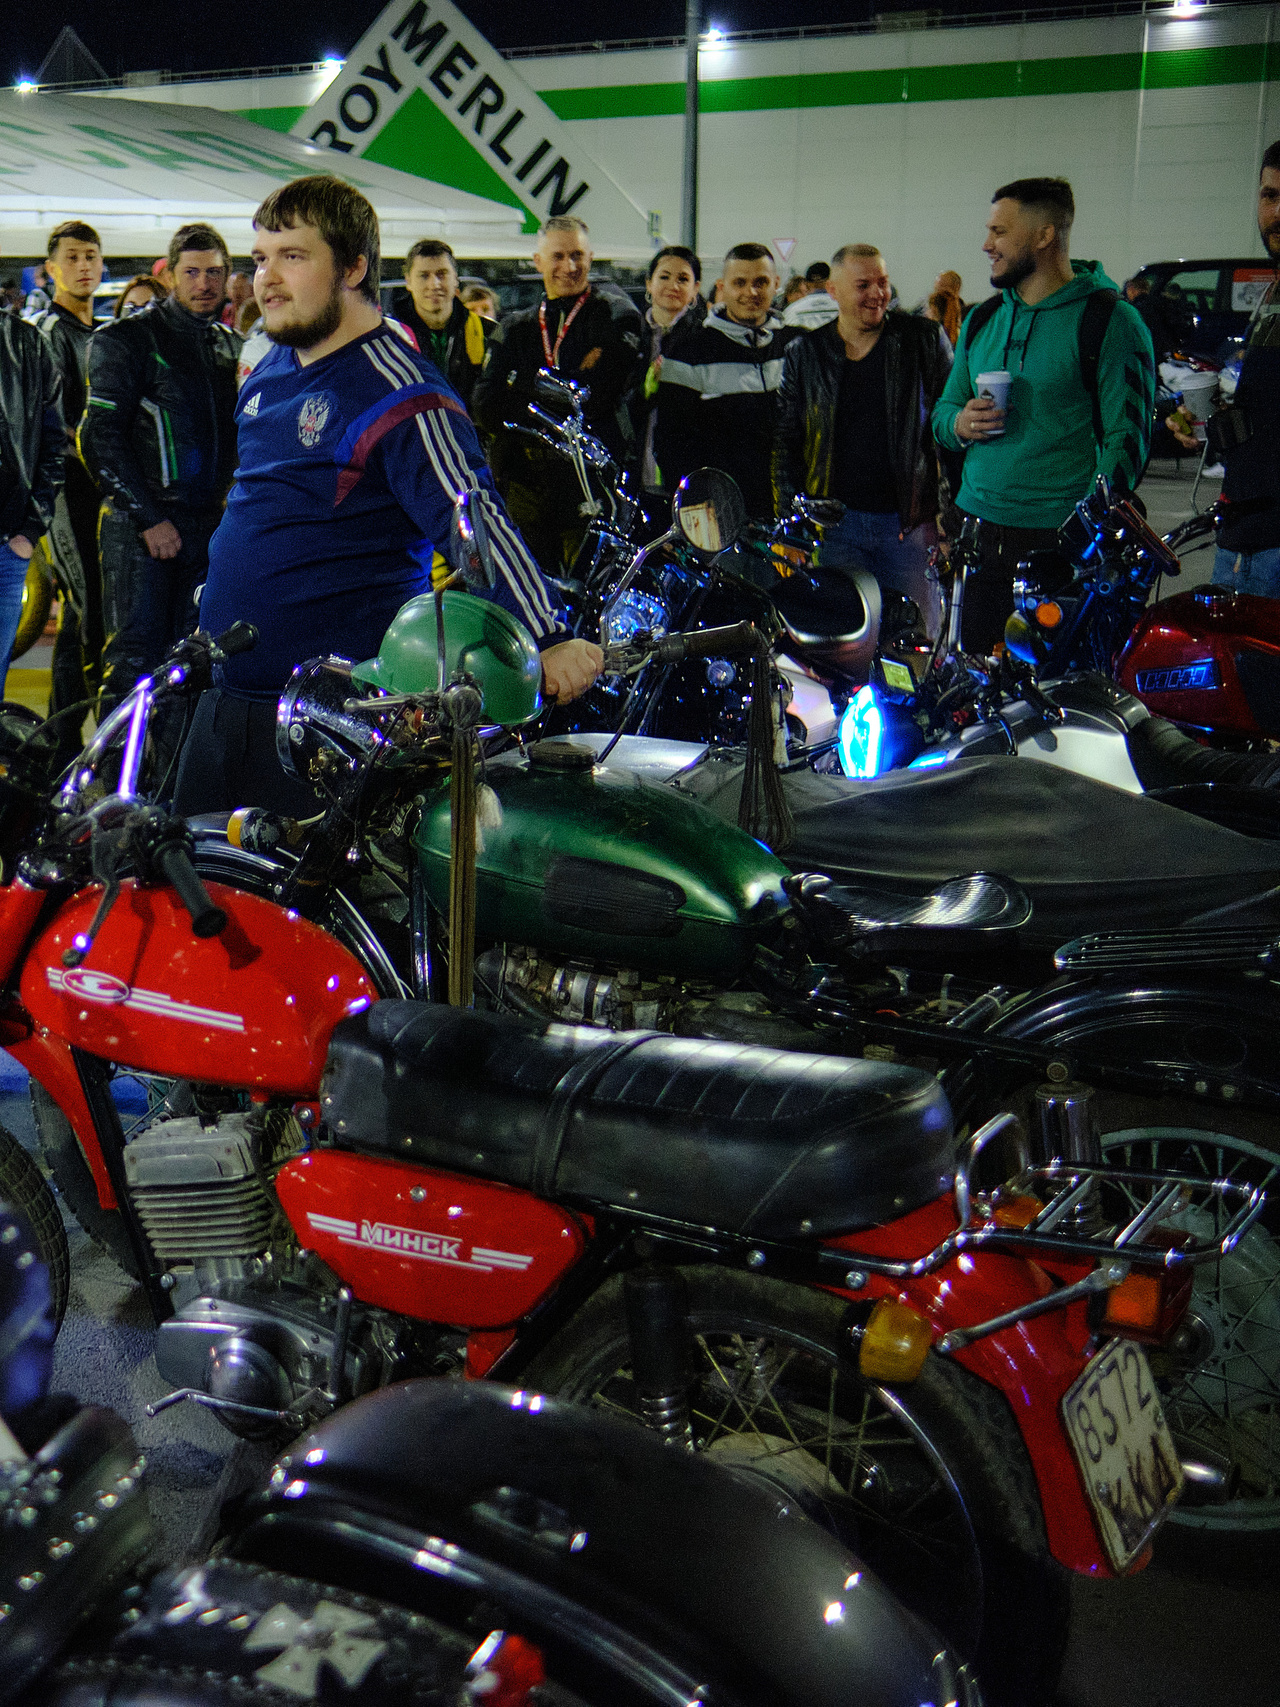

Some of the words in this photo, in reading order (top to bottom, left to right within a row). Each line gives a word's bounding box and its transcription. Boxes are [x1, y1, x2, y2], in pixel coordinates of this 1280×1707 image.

[309, 43, 404, 153] ROY
[390, 0, 590, 217] MERLIN
[361, 1219, 461, 1260] МИНСК
[1077, 1346, 1152, 1463] 8372
